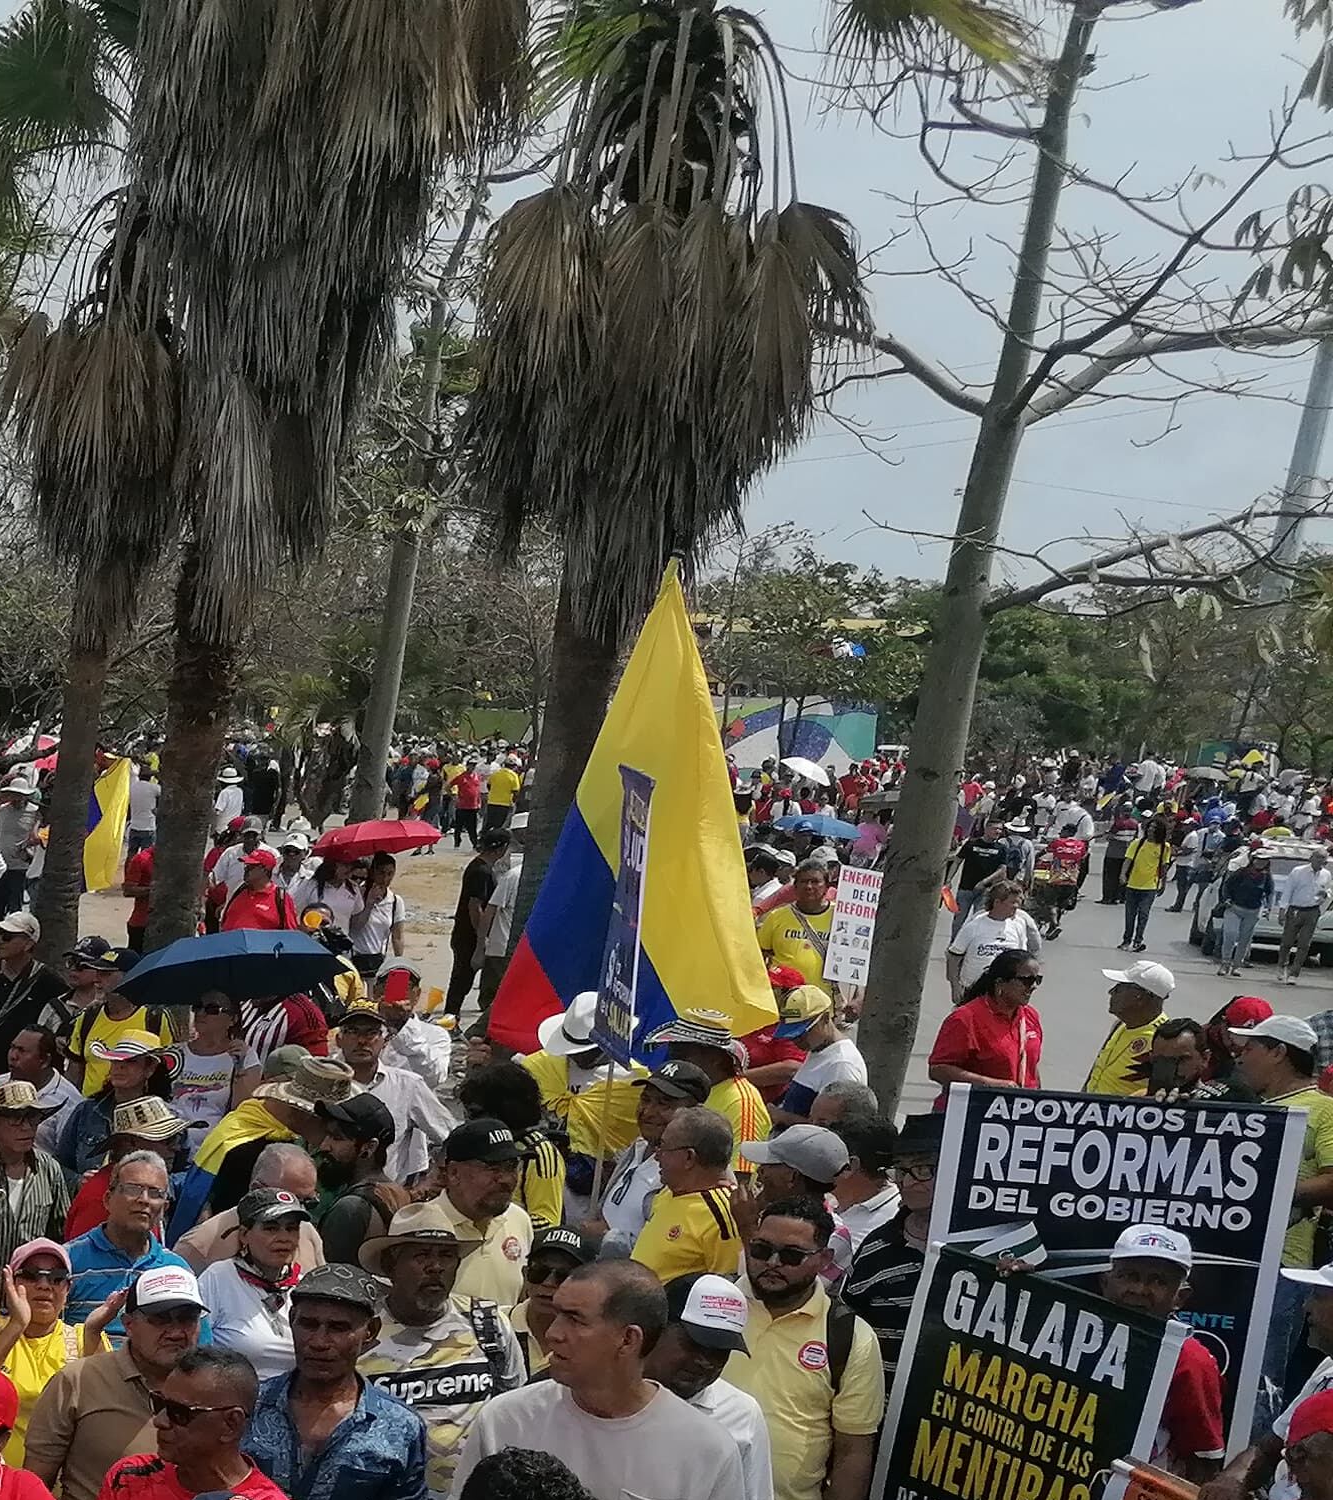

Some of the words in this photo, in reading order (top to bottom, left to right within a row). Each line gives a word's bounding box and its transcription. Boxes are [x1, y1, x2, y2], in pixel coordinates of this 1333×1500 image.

[985, 1096, 1186, 1132] APOYAMOS
[1195, 1110, 1267, 1138] LAS
[973, 1122, 1262, 1202] REFORMAS
[543, 1229, 582, 1249] ADEBA
[968, 1185, 1039, 1215] DEL
[1049, 1192, 1252, 1232] GOBIERNO
[942, 1270, 1131, 1391] GALAPA
[373, 1374, 493, 1406] Supreme
[942, 1341, 1099, 1445] MARCHA
[931, 1389, 957, 1422] EN
[961, 1400, 1027, 1452] CONTRA
[1030, 1430, 1056, 1464] DE
[1057, 1440, 1094, 1478] LAS
